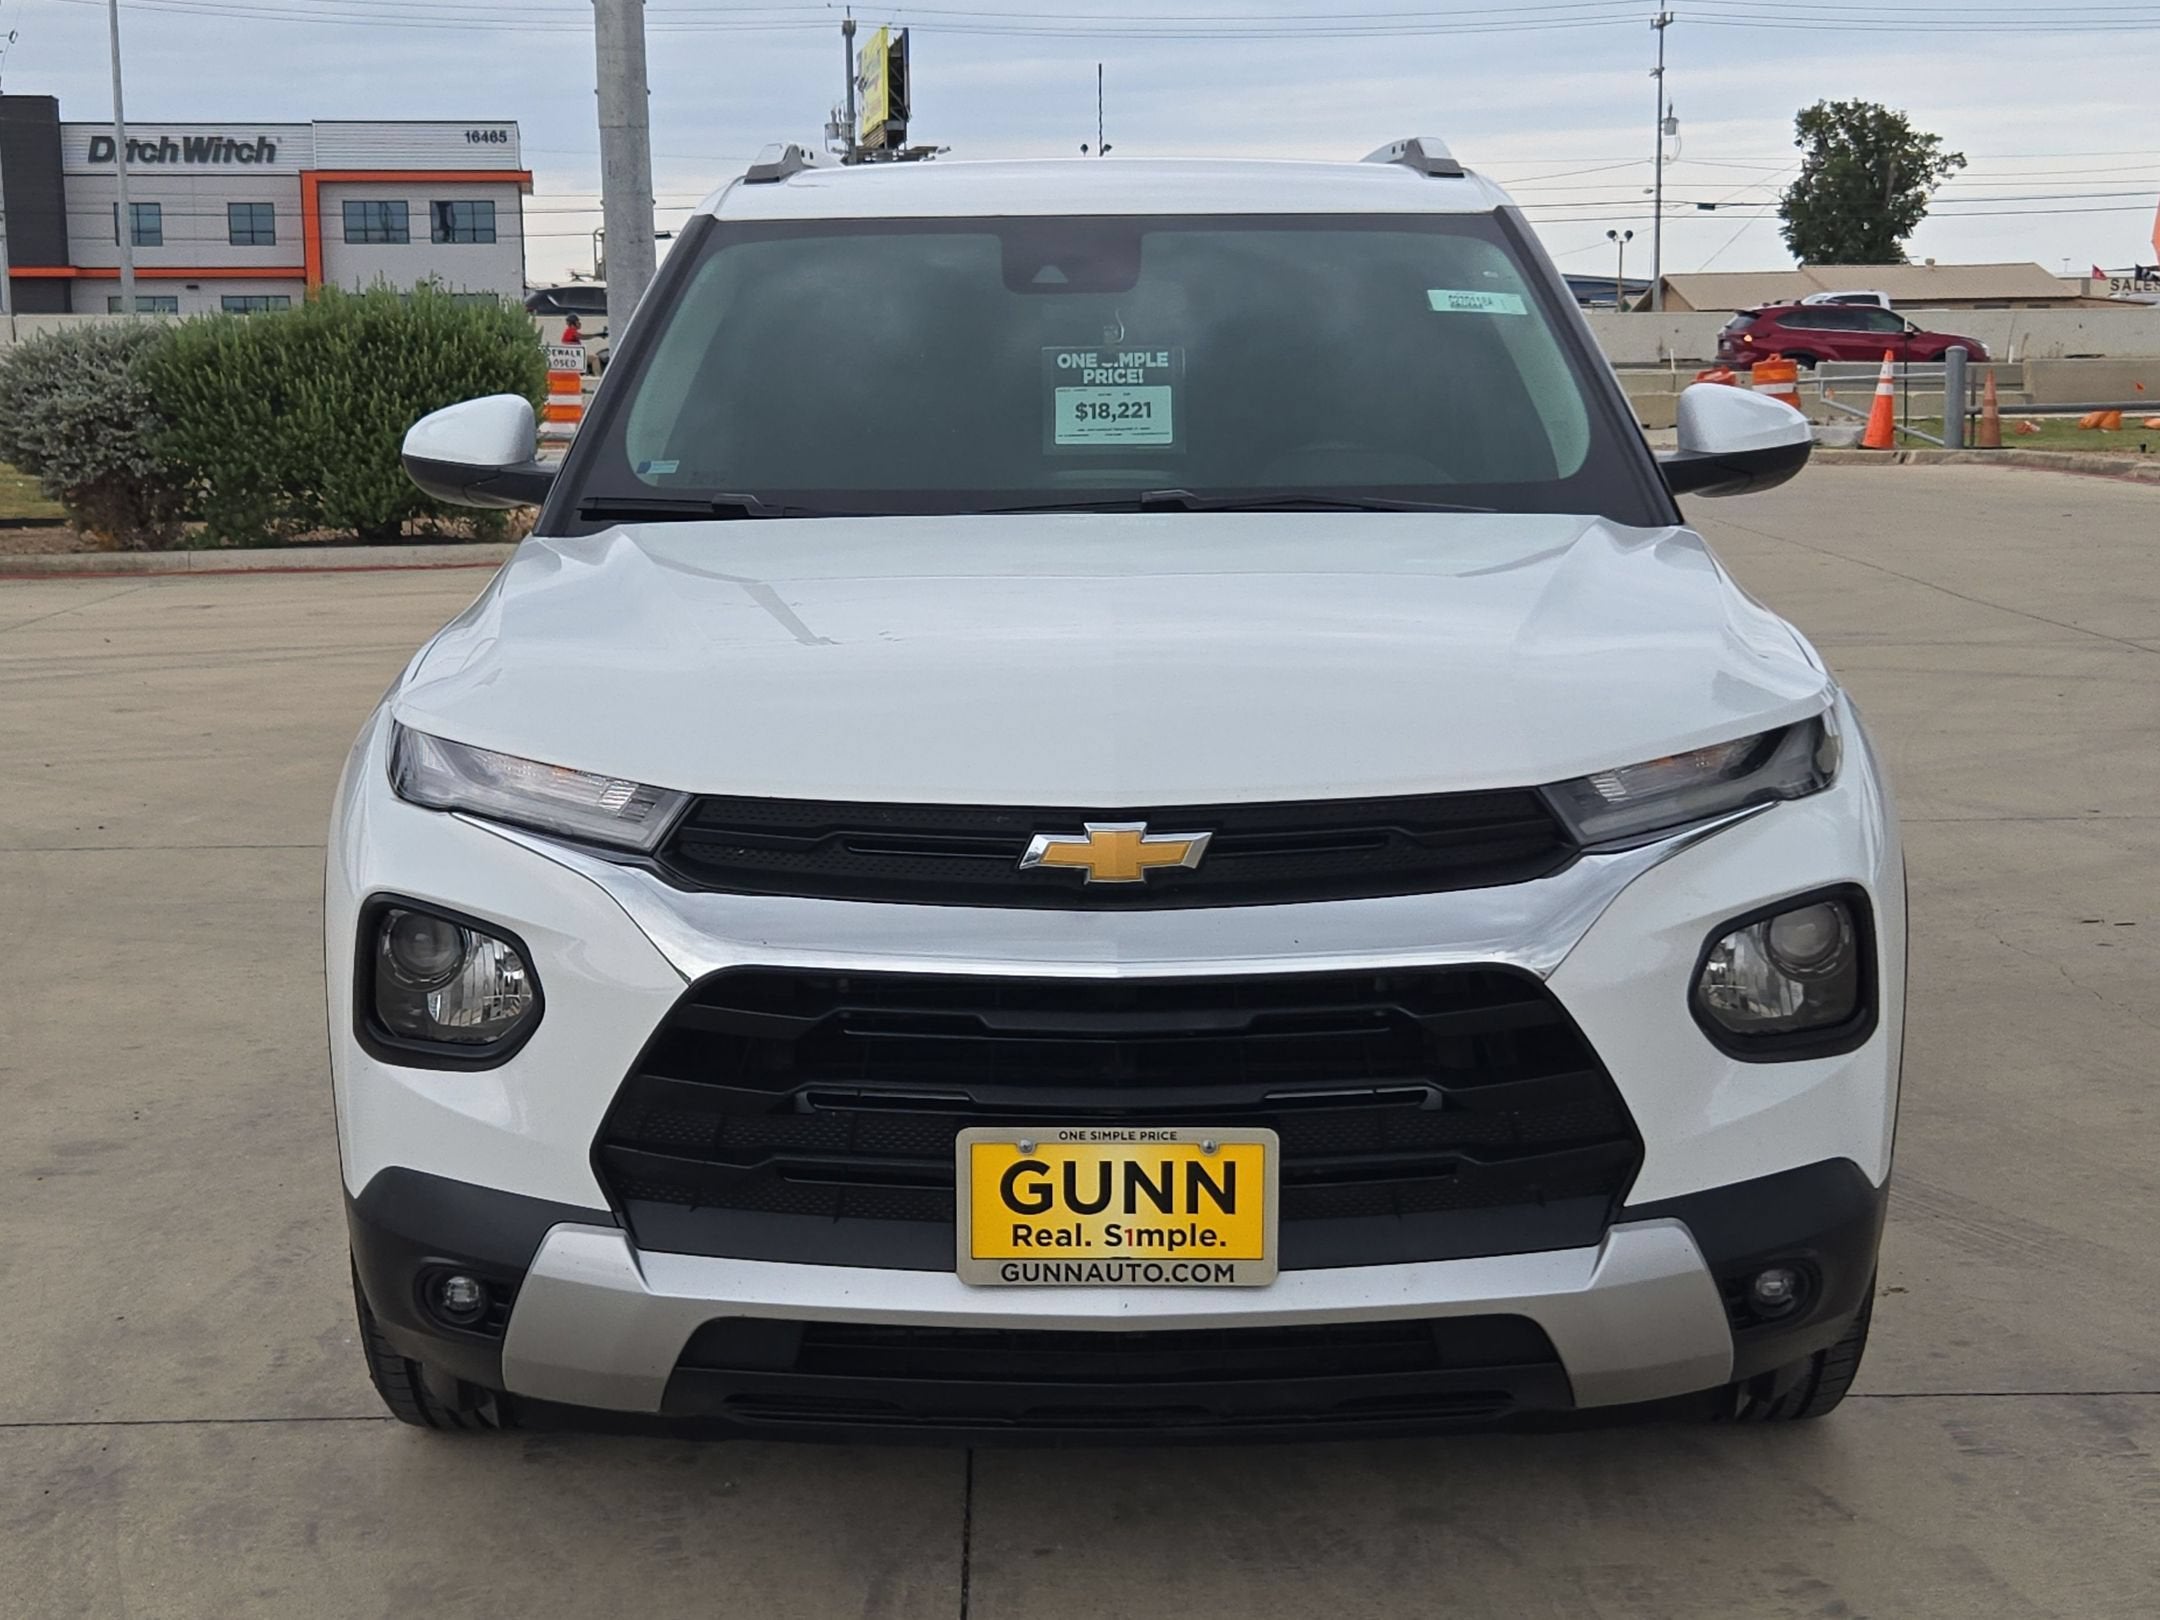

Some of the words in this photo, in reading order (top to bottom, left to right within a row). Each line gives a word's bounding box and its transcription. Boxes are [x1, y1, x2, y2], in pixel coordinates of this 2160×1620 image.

[464, 130, 508, 144] 16465
[87, 135, 180, 164] Dtch
[182, 135, 277, 164] Witch
[1057, 352, 1098, 369] ONE
[1101, 351, 1169, 368] MPLE
[1083, 368, 1144, 384] PRICE!
[1074, 401, 1152, 423] $18,221
[1058, 1130, 1087, 1141] ONE
[1090, 1130, 1136, 1141] SIMPLE
[1139, 1130, 1178, 1141] PRICE
[999, 1159, 1236, 1215] GUNN
[1011, 1223, 1092, 1247] Real.
[1001, 1262, 1235, 1283] GUNNAUTO.COM
